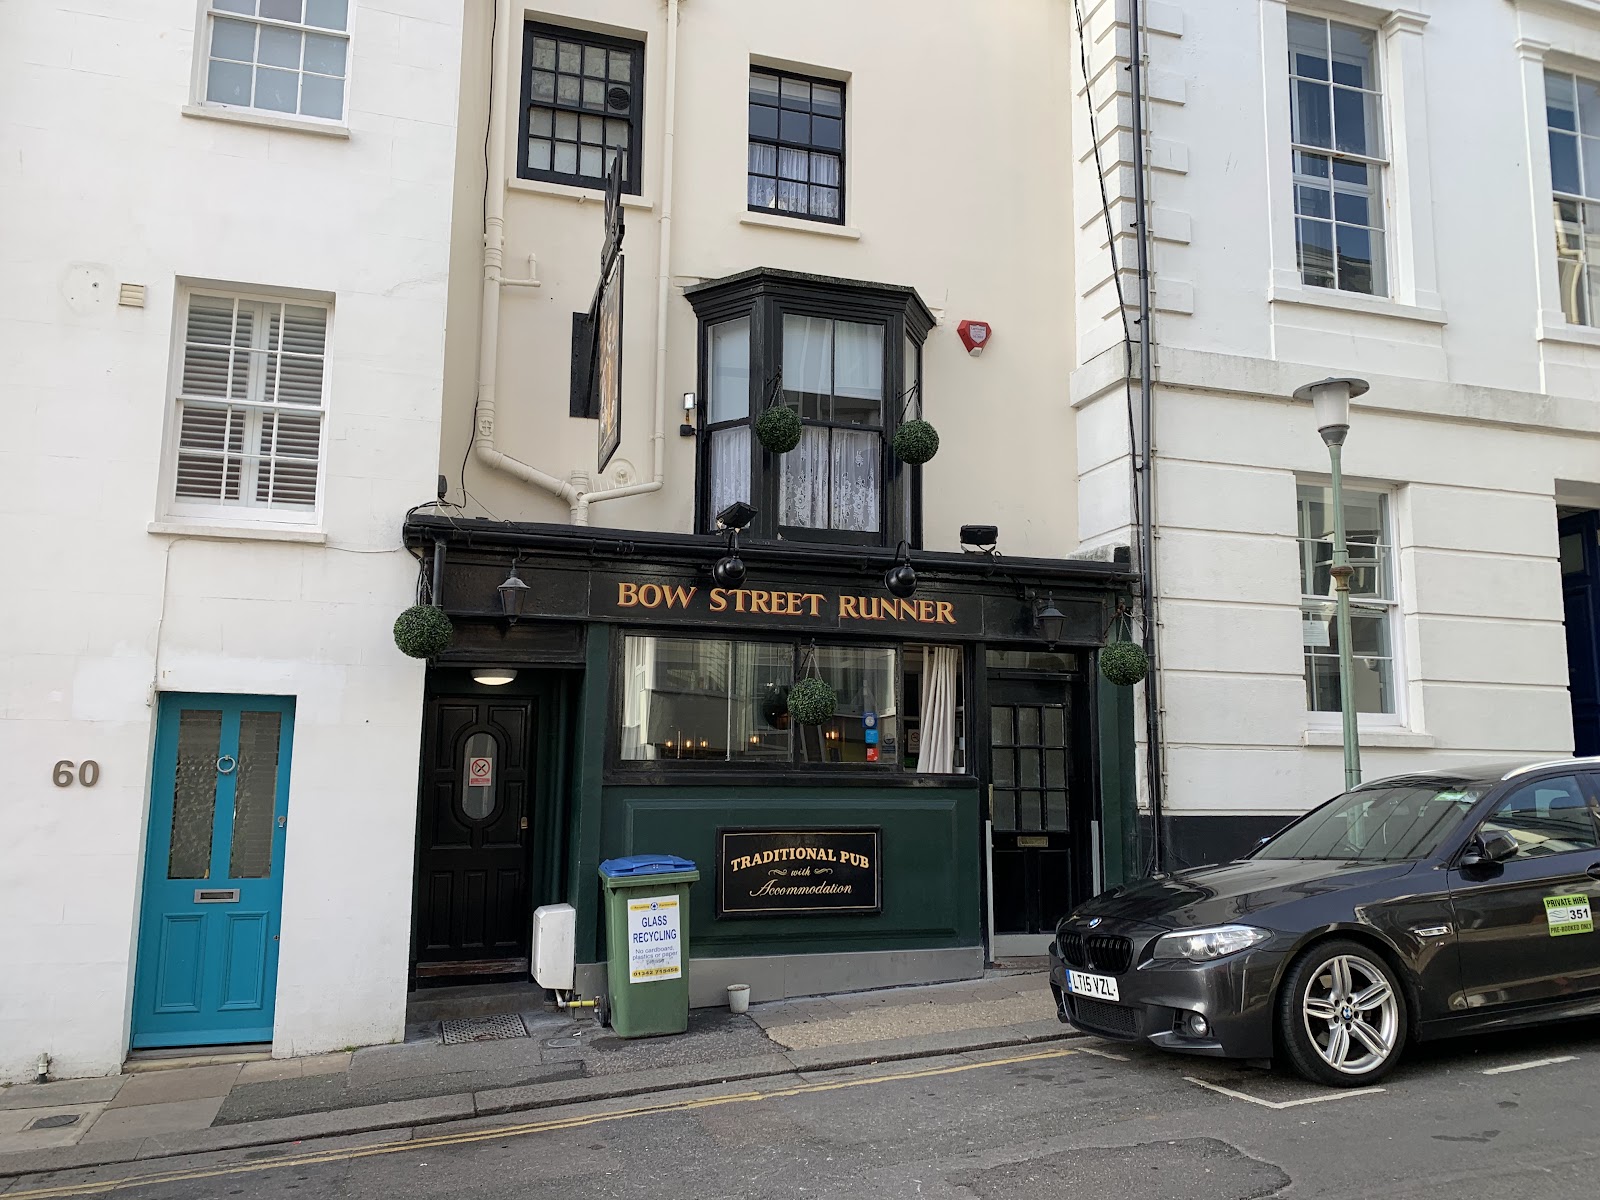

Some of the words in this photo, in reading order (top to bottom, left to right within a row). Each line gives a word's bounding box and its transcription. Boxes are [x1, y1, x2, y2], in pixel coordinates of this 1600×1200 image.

[617, 582, 697, 609] BOW
[709, 587, 828, 617] STREET
[838, 595, 957, 624] RUNNER
[53, 760, 99, 787] 60
[730, 847, 836, 872] TRADITIONAL
[839, 850, 870, 869] PUB
[790, 866, 811, 877] with
[749, 878, 852, 897] Accommodation
[1546, 898, 1572, 908] PRIVATE
[1572, 896, 1588, 905] HIRE
[641, 915, 668, 928] GLASS
[1569, 908, 1589, 920] 351
[632, 929, 677, 944] RECYCLING
[632, 953, 654, 961] plastics
[661, 951, 678, 959] paper
[1072, 973, 1092, 992] LT15
[1093, 977, 1115, 996] VZL
